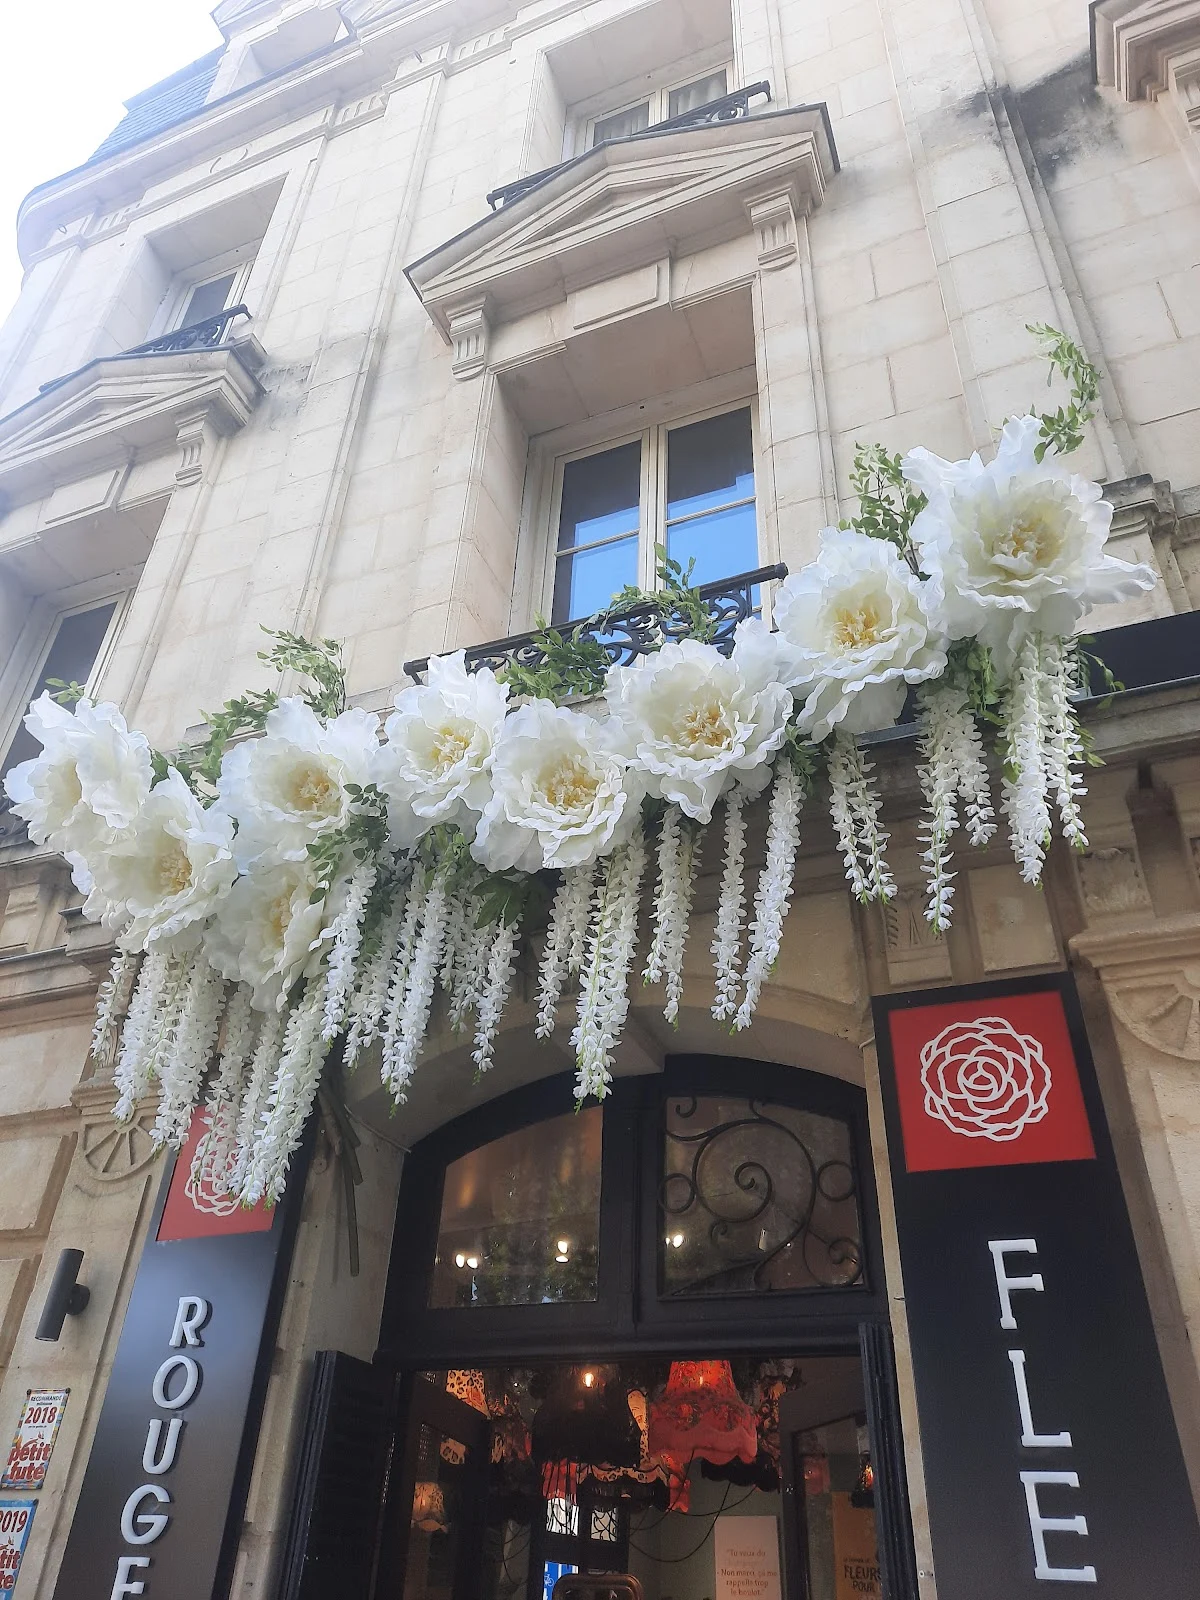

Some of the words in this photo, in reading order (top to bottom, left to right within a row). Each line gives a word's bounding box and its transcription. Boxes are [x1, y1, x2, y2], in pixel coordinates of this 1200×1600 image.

[24, 1406, 58, 1424] 2018
[988, 1238, 1097, 1582] FLE
[7, 1441, 51, 1466] petit
[9, 1461, 45, 1483] futé
[0, 1548, 20, 1570] tit
